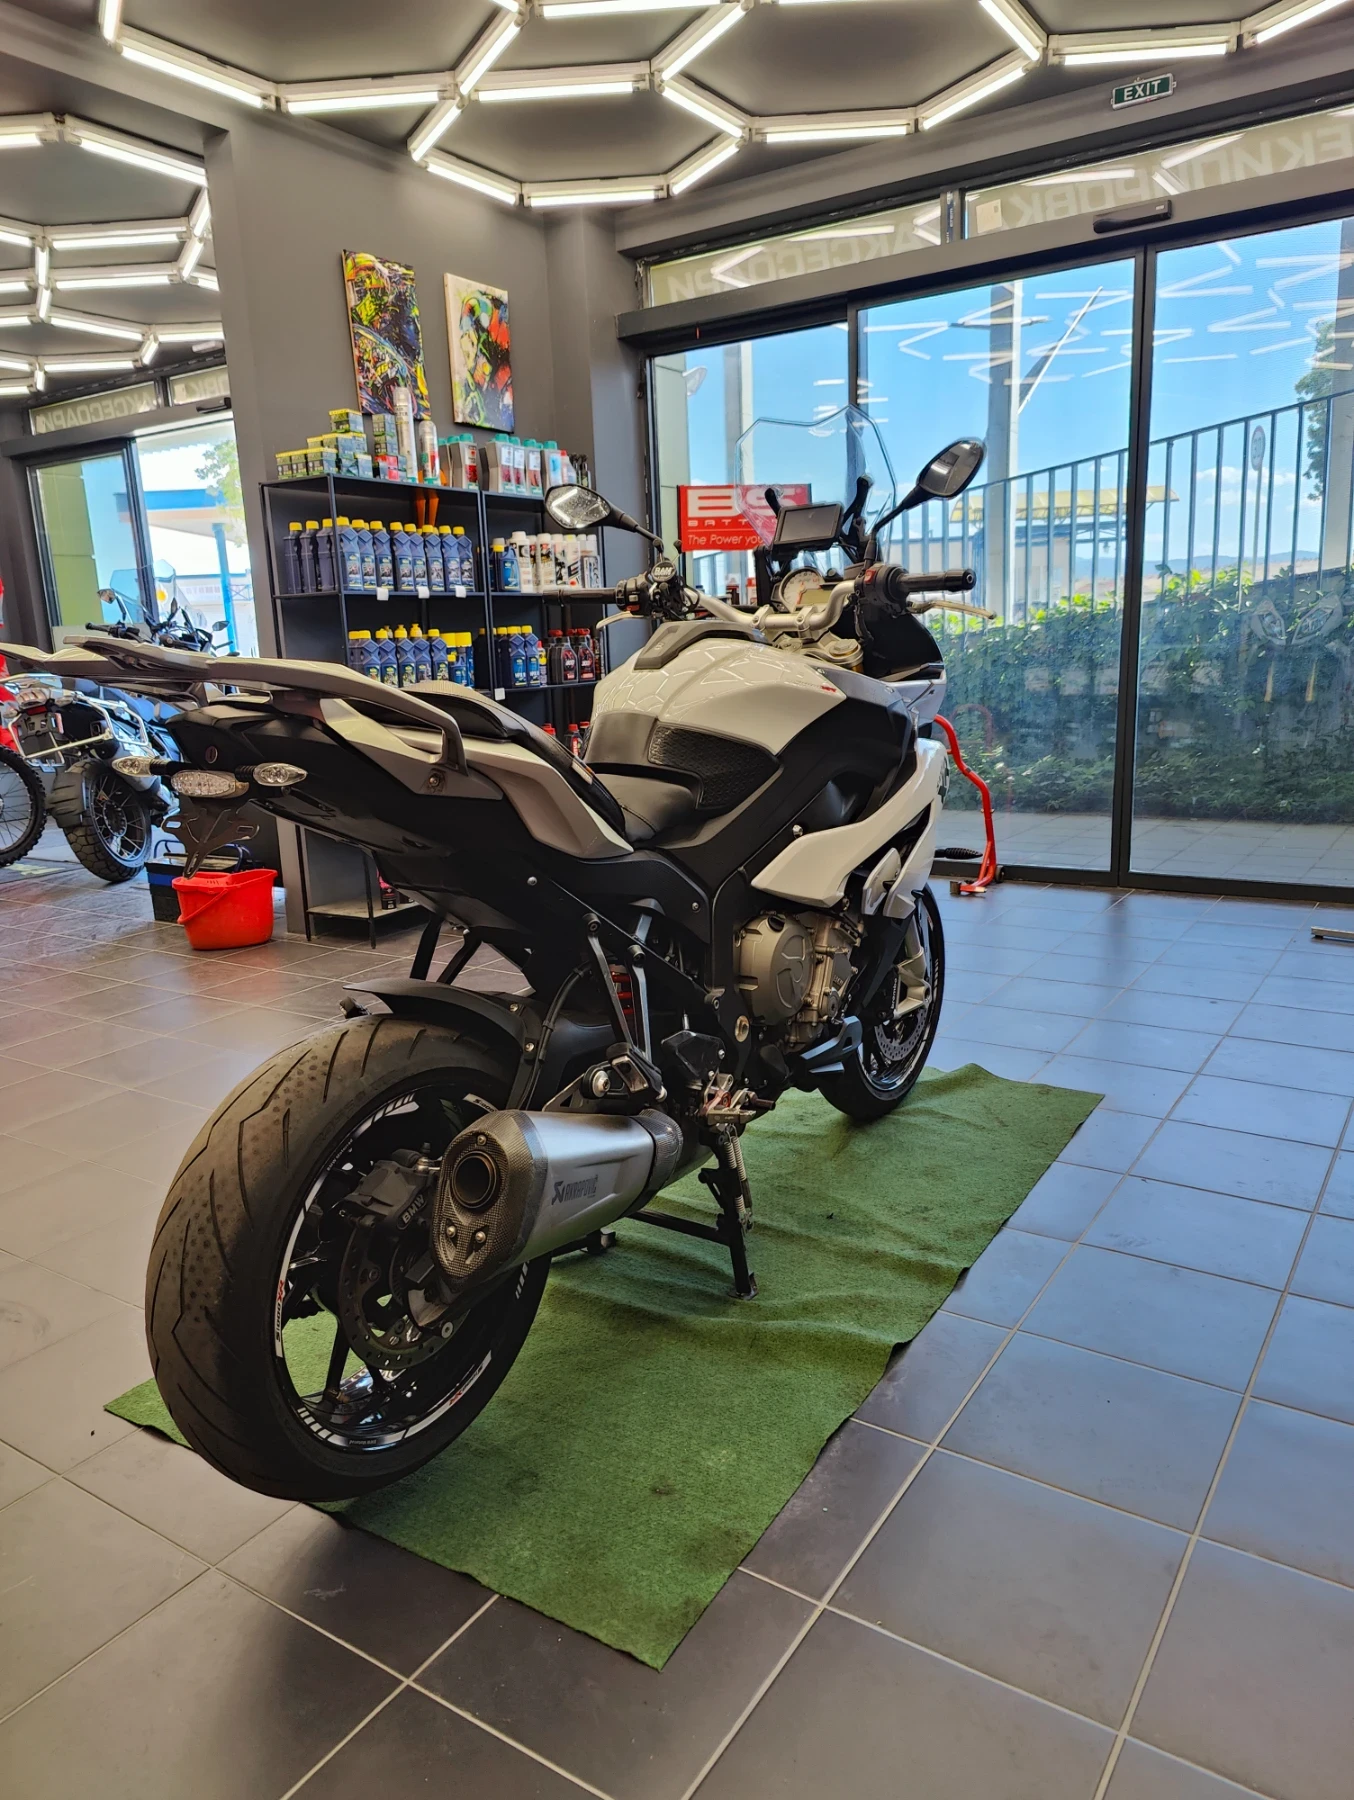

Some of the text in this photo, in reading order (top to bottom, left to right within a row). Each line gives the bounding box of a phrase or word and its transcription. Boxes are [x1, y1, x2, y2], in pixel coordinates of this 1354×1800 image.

[1123, 80, 1161, 101] EXIT
[687, 519, 758, 527] BATT
[687, 534, 707, 545] The
[710, 534, 743, 545] Power
[401, 1194, 426, 1224] BMW
